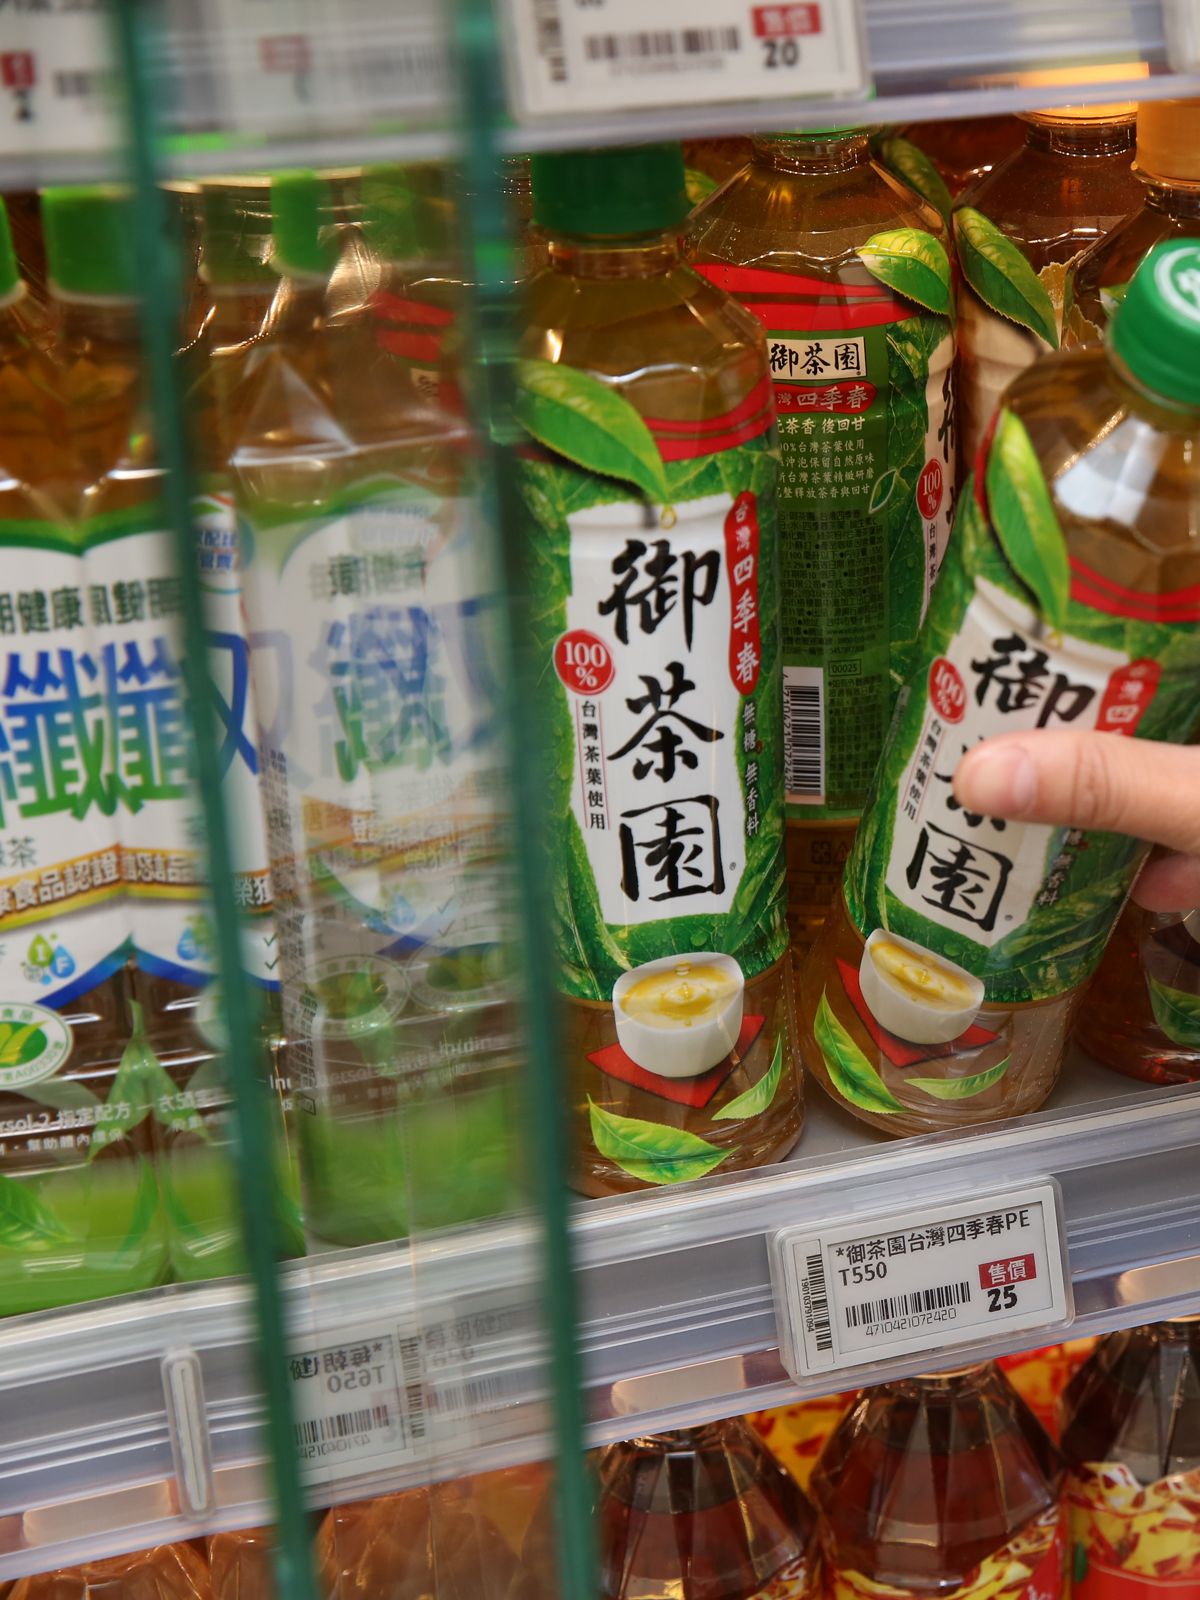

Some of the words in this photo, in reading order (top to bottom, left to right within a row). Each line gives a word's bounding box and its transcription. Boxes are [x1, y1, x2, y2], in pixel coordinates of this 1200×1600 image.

[763, 40, 800, 70] 20
[770, 342, 861, 377] 御茶園
[822, 416, 866, 433] 後回甘
[778, 452, 875, 469] 沖泡保留自然原味
[732, 501, 760, 686] 台灣四季春
[564, 641, 606, 688] 100%
[597, 538, 725, 902] 御茶園
[1103, 662, 1149, 737] 台灣四
[742, 701, 757, 753] 無糖
[580, 700, 606, 831] 台灣茶葉使用
[905, 632, 1097, 932] 御園
[745, 761, 760, 837] 無香料
[838, 1261, 888, 1286] T550
[988, 1259, 1027, 1285] 售價
[987, 1285, 1018, 1313] 25
[866, 1307, 957, 1337] 4710421072420
